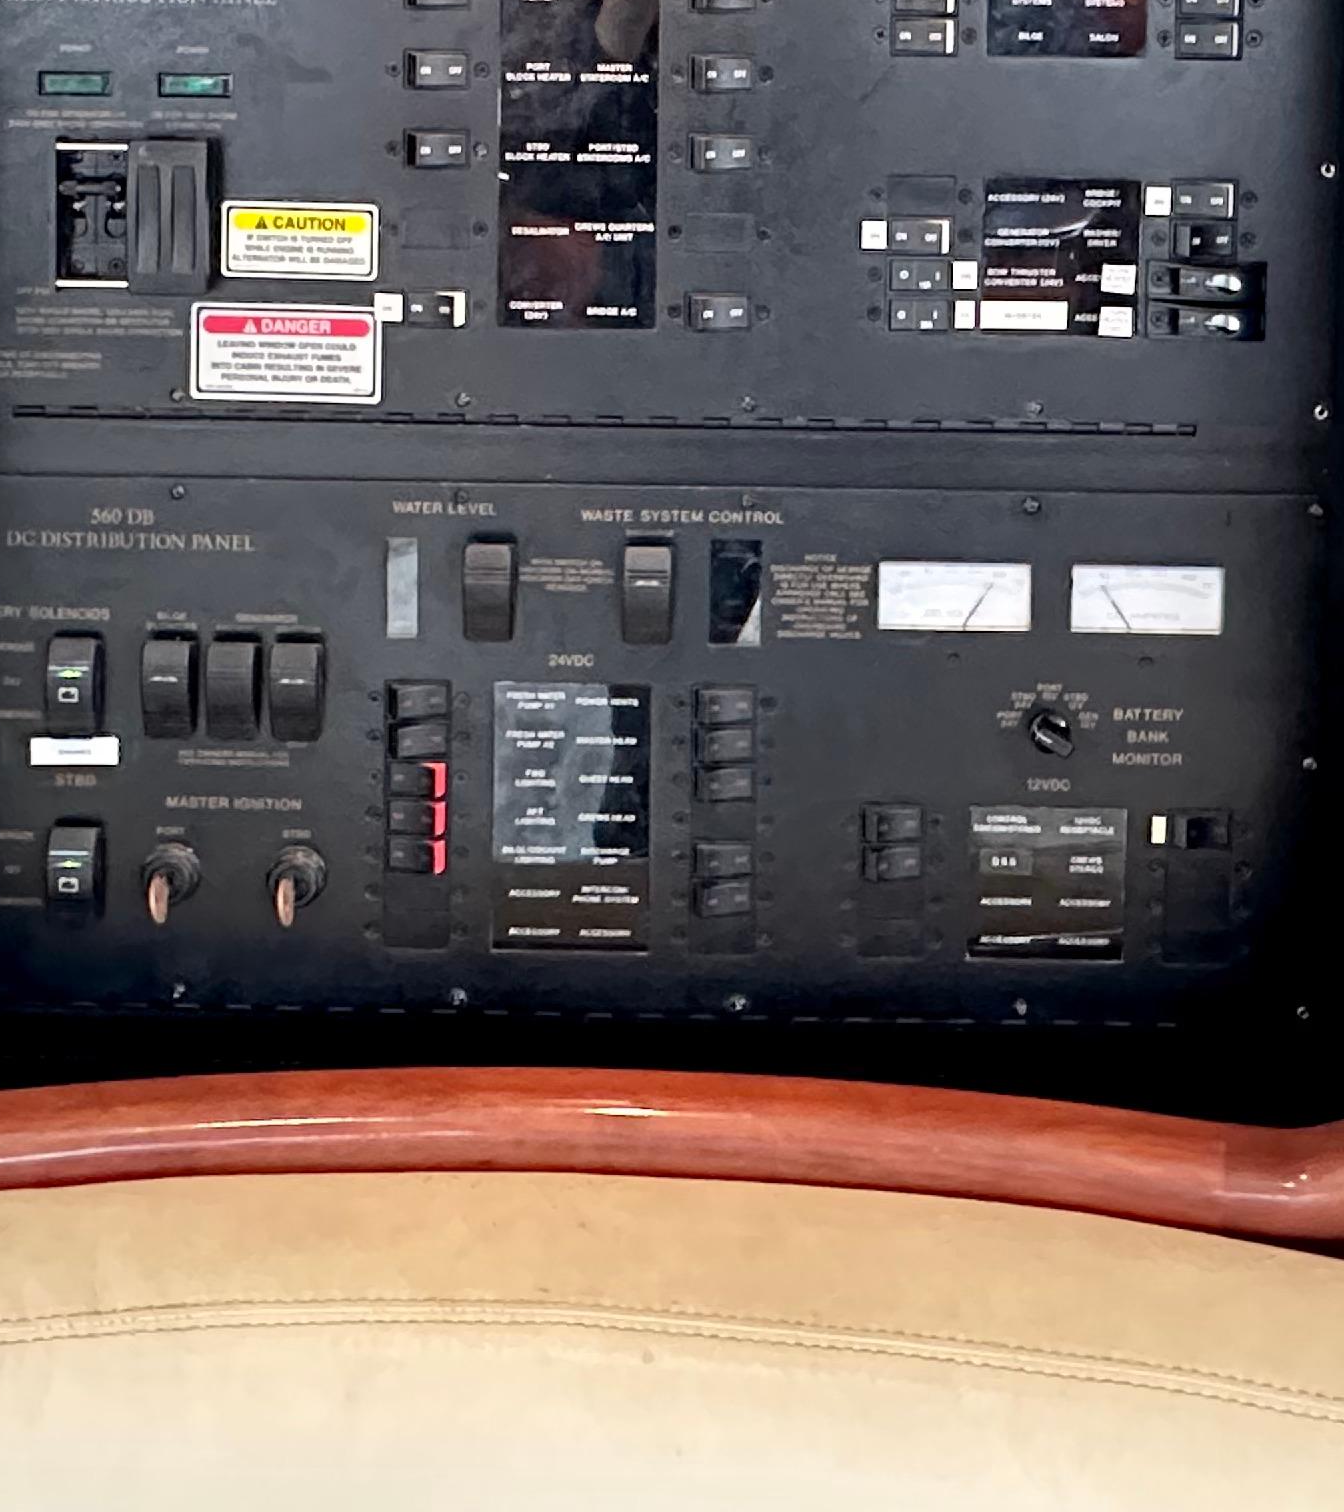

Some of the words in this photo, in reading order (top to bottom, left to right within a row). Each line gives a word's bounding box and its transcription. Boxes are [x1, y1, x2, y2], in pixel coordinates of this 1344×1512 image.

[273, 216, 346, 231] CAUTION
[261, 319, 331, 334] DANGER
[392, 501, 443, 515] WATER
[448, 502, 497, 516] LEVEL
[92, 508, 122, 525] 560
[128, 509, 154, 526] DB
[580, 509, 633, 522] WASTE
[640, 509, 704, 523] SYSTEM
[709, 510, 784, 525] CONTROL
[7, 531, 36, 547] DC
[41, 531, 186, 551] DISTRIBUTION
[191, 534, 256, 552] PANEL
[549, 654, 594, 668] 24VDC
[1113, 708, 1183, 721] BATTERY
[1127, 730, 1169, 743] BANK
[1112, 753, 1182, 766] MONITOR
[55, 773, 96, 786] STBD
[1026, 778, 1071, 791] 12VDC
[165, 796, 229, 809] MASTER
[233, 797, 302, 810] IGNITION
